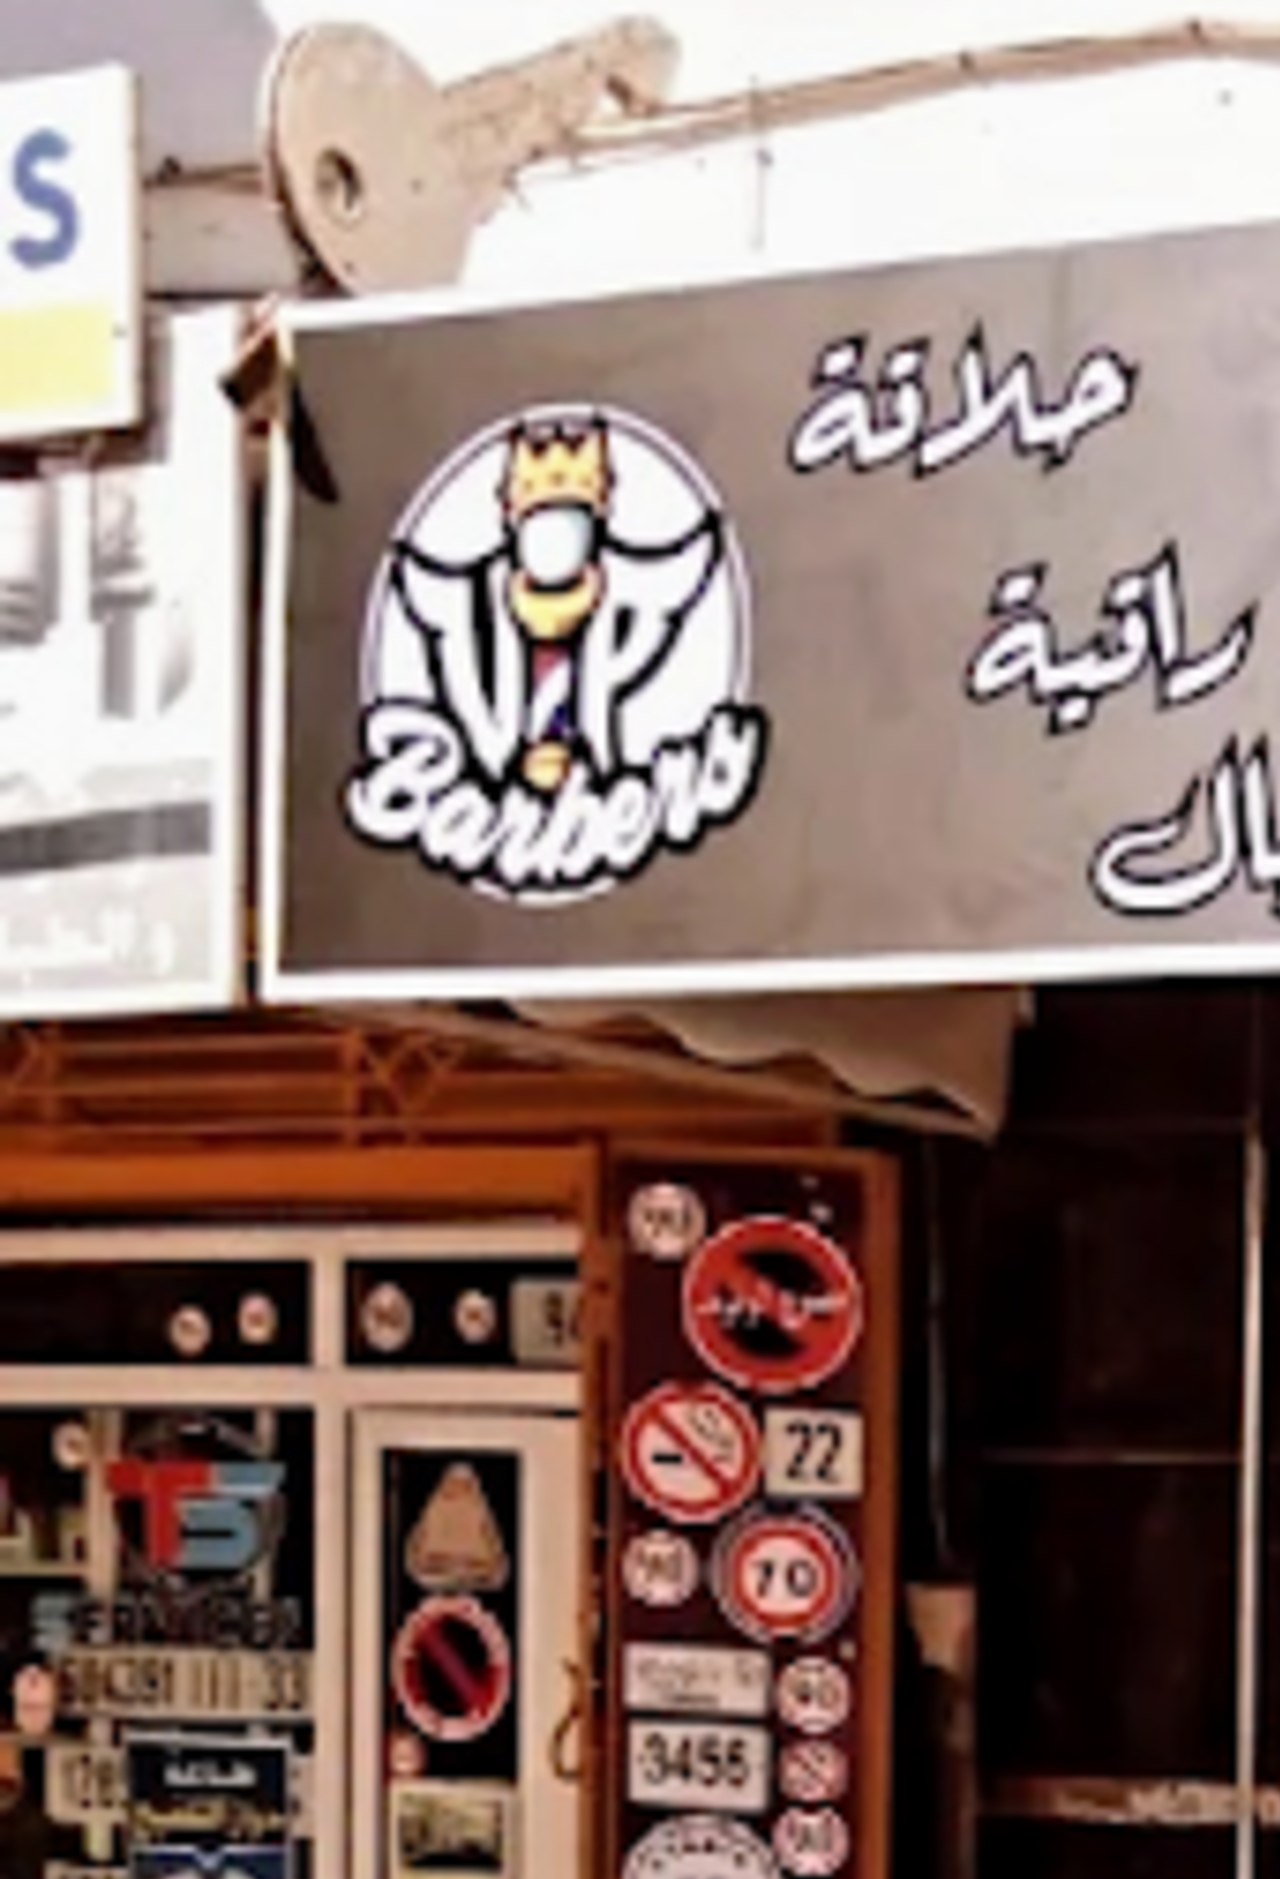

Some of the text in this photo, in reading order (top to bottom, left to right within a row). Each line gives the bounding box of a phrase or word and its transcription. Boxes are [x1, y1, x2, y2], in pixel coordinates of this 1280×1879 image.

[788, 317, 1138, 478] حلاقة
[964, 538, 1258, 737] راقية
[340, 692, 768, 888] Barbers
[104, 1459, 286, 1570] TS
[783, 1419, 844, 1485] 22
[748, 1558, 819, 1599] 70
